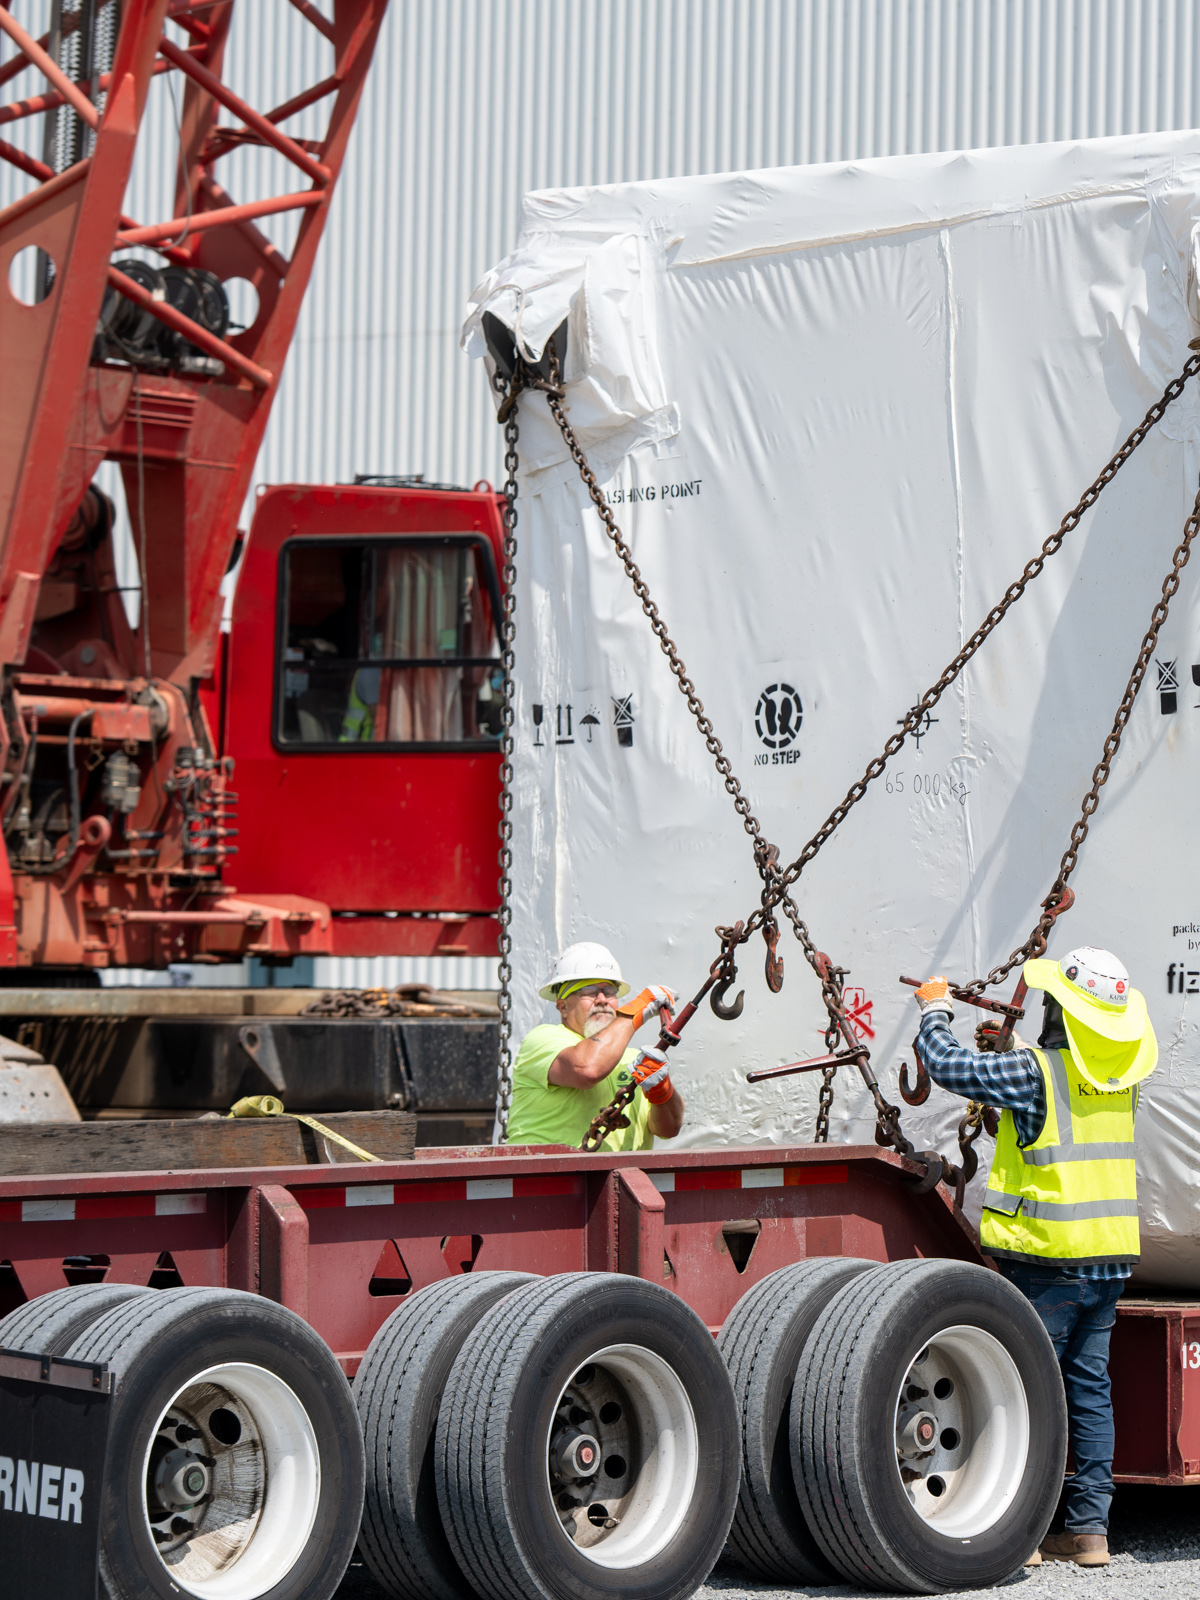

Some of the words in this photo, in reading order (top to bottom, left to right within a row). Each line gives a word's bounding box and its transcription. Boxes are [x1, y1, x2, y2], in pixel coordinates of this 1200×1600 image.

[661, 480, 703, 500] POINT
[753, 752, 770, 766] NO
[771, 749, 802, 766] STEP
[886, 770, 904, 794] 65
[913, 774, 941, 796] 000
[949, 776, 972, 806] kg
[1188, 938, 1200, 951] by
